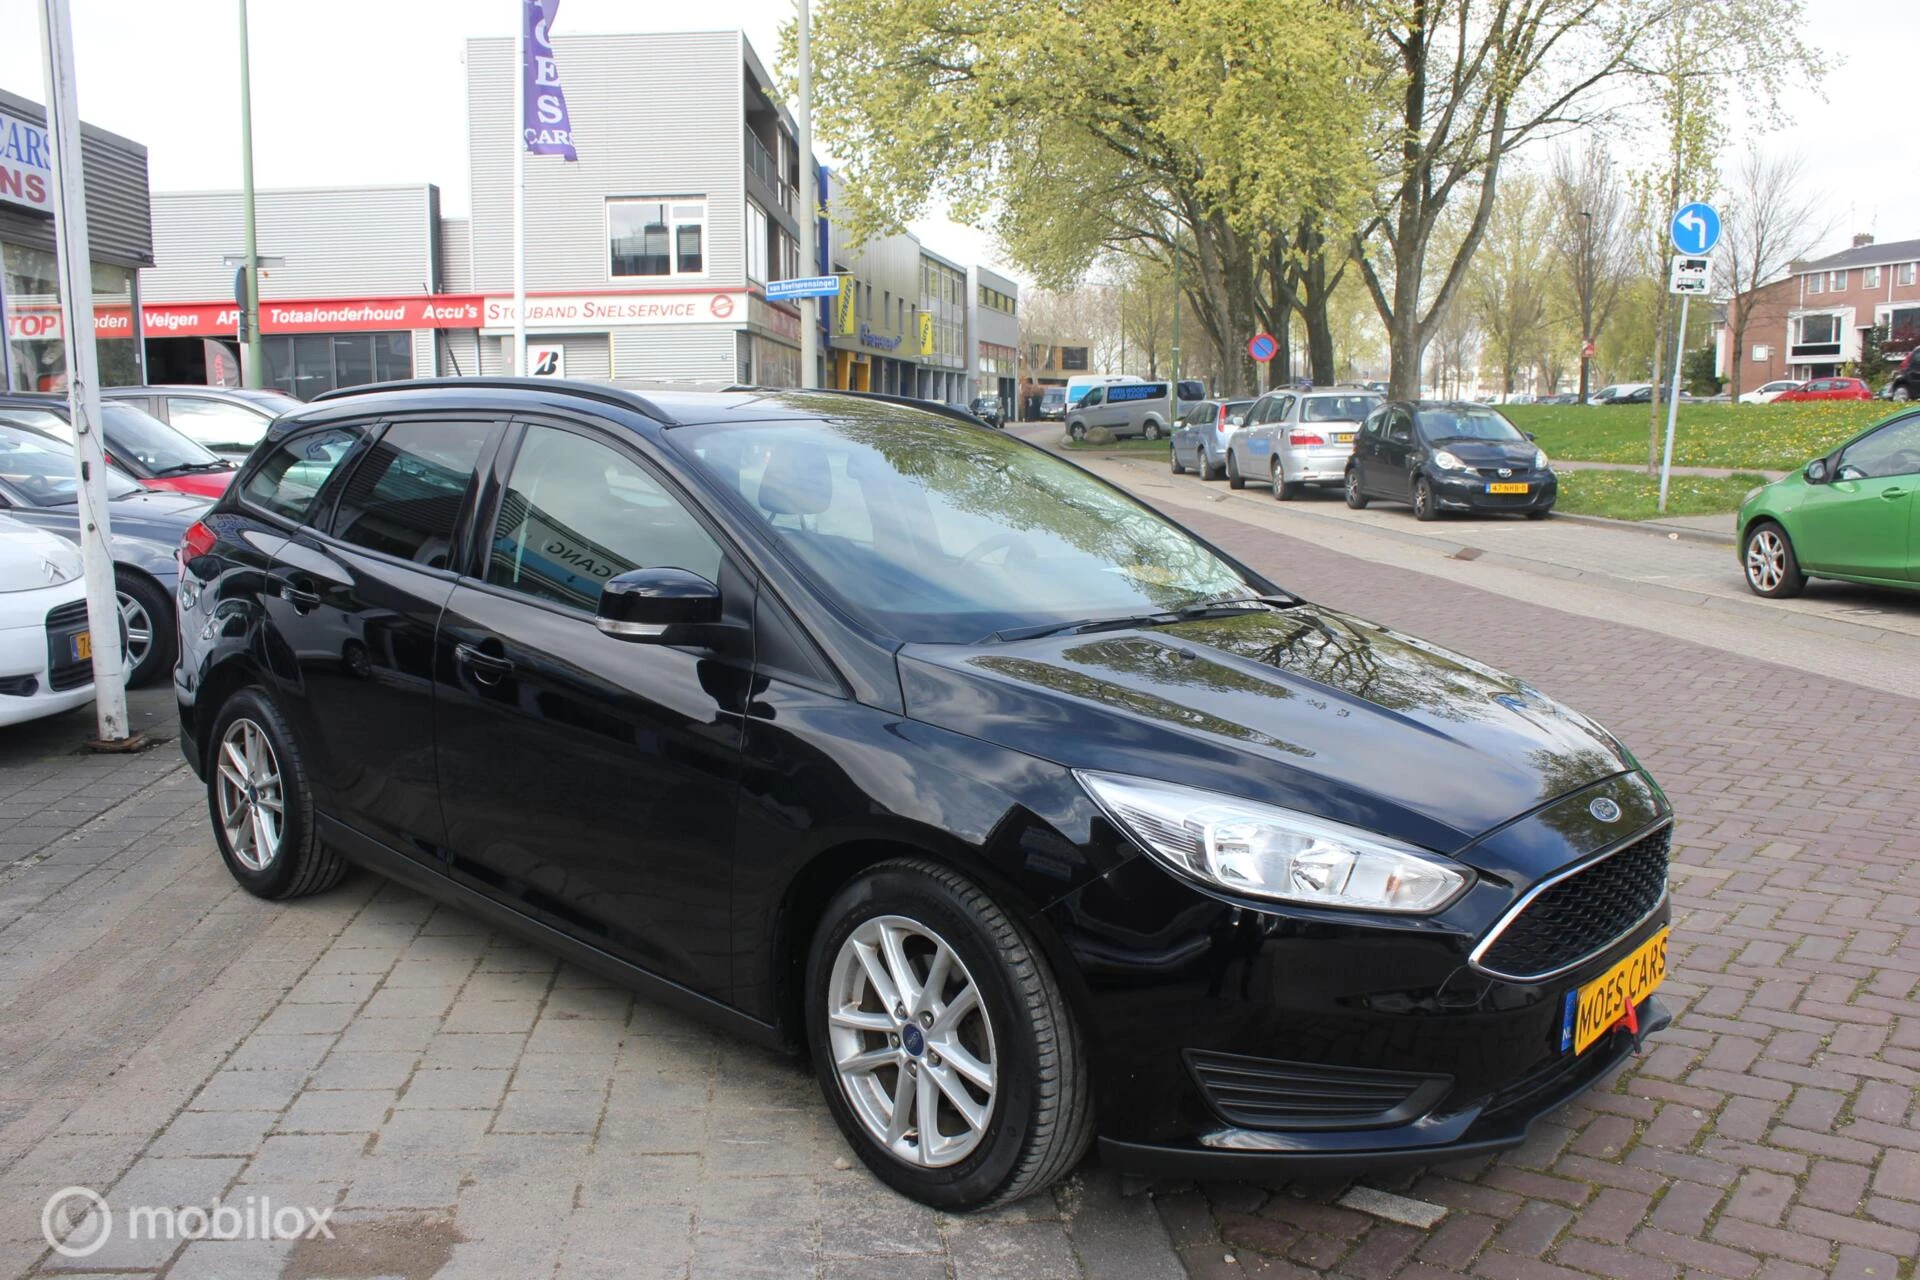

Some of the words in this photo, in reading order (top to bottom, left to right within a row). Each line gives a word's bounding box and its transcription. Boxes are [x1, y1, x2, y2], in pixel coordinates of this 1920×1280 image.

[145, 313, 198, 330] Velgen
[216, 311, 240, 325] AP
[271, 305, 405, 323] Totaalonderhoud
[421, 304, 478, 320] Accu's
[1578, 971, 1625, 1044] MOES
[1628, 936, 1667, 999] CARS
